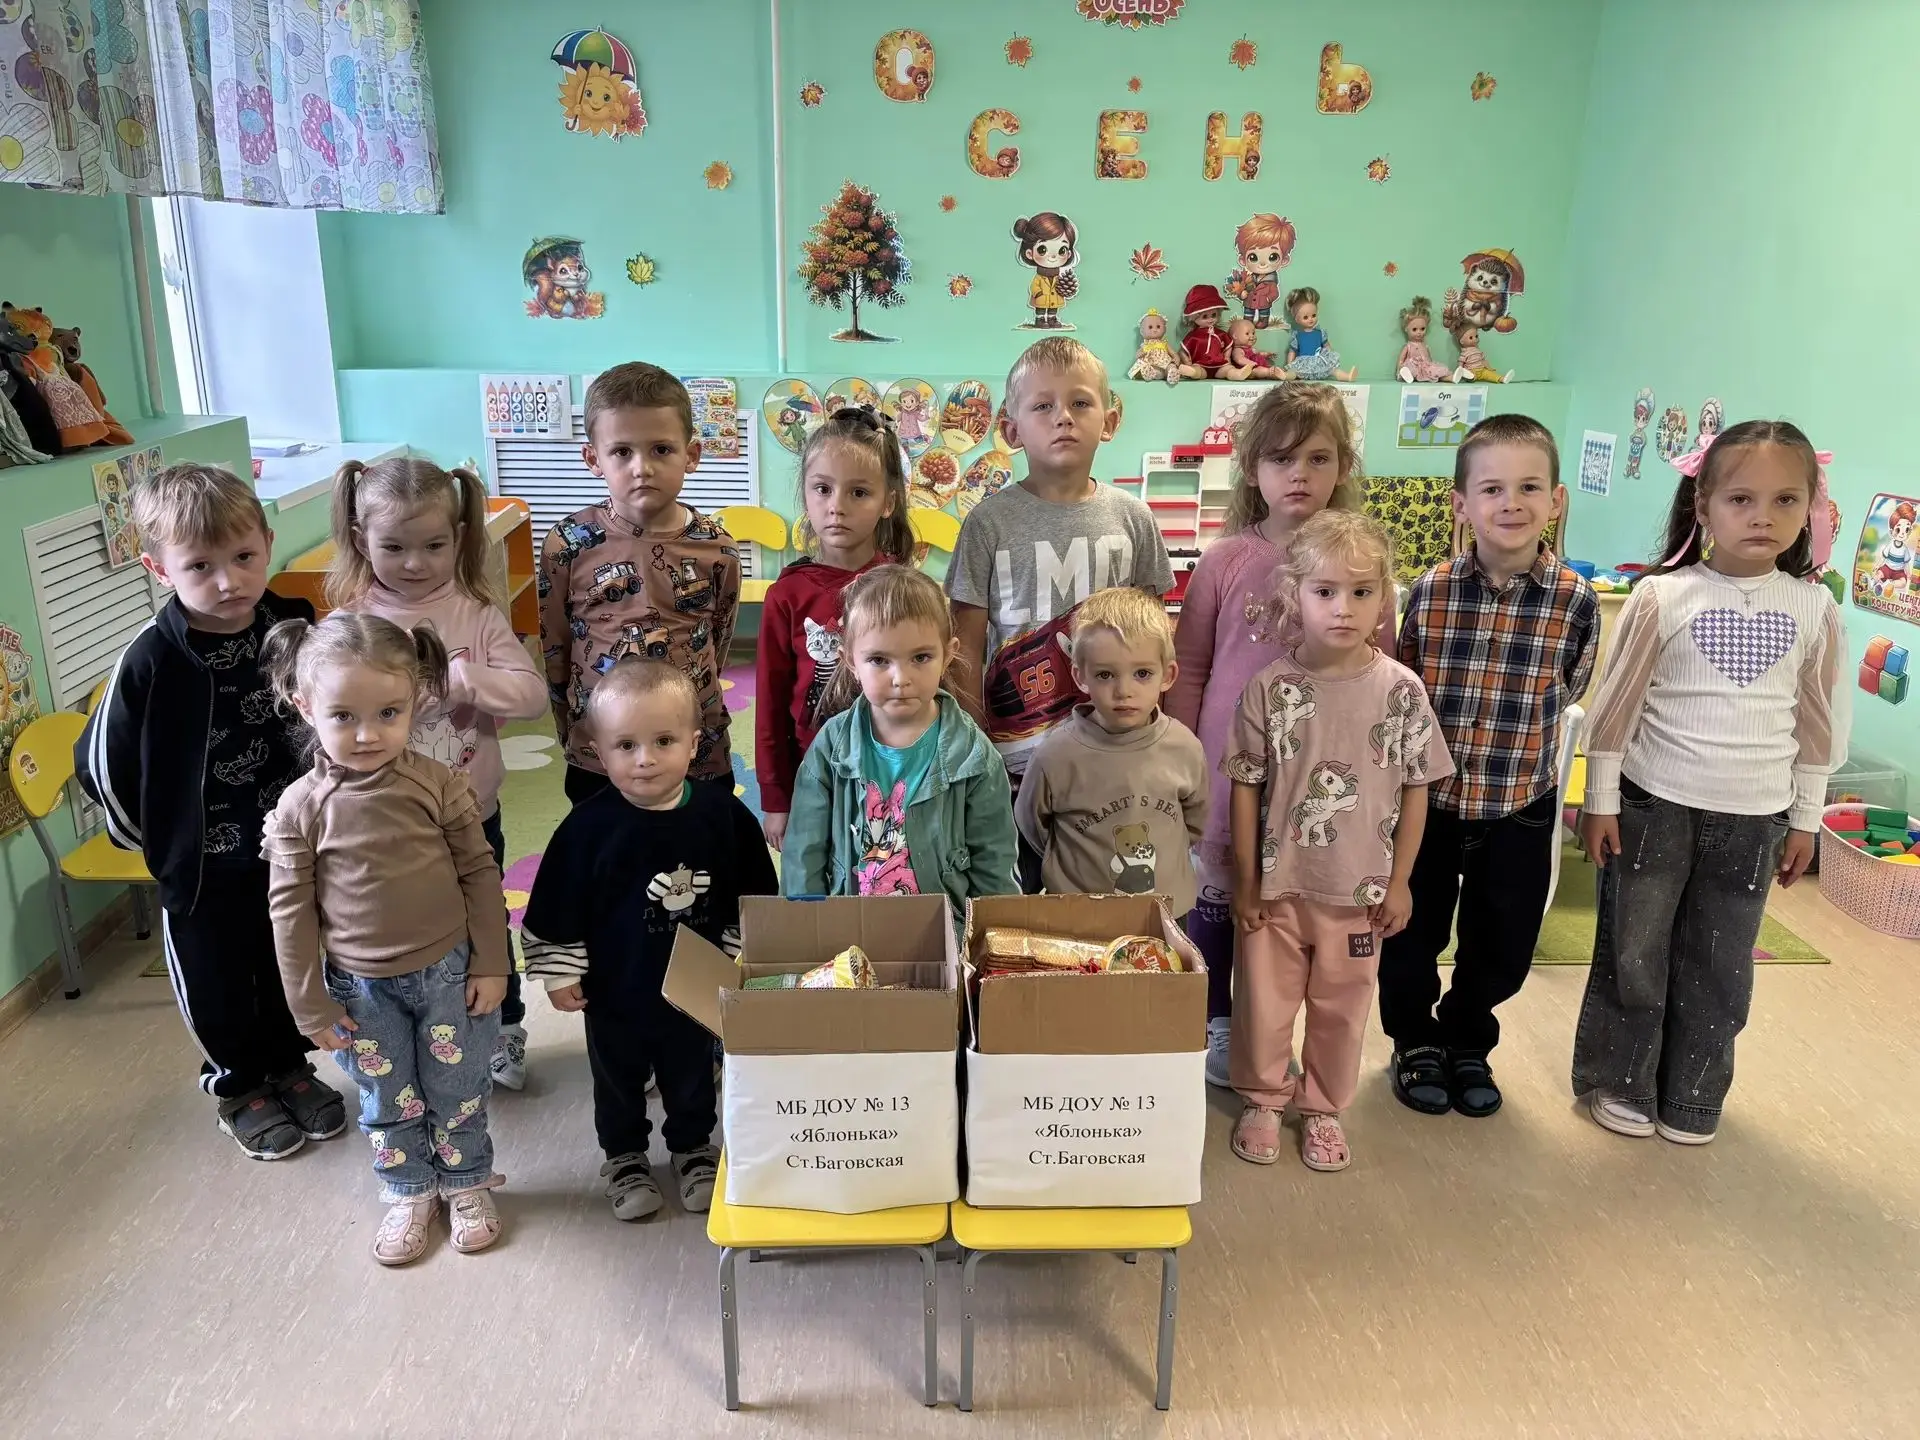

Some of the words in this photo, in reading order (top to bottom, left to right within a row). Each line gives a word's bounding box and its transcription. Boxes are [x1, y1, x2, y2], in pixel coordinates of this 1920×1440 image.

[1438, 391, 1452, 400] Суп
[1355, 936, 1370, 945] OK
[776, 1100, 807, 1115] МБ
[812, 1098, 857, 1117] ДОУ
[891, 1096, 910, 1111] 13
[1023, 1096, 1054, 1111] МБ
[1059, 1096, 1104, 1114] ДОУ
[1137, 1095, 1155, 1110] 13
[790, 1127, 898, 1143] «Яблонька»
[1035, 1124, 1142, 1139] «Яблонька»
[786, 1154, 904, 1171] Ст.Баговская
[1028, 1150, 1146, 1165] Ст.Баговская
